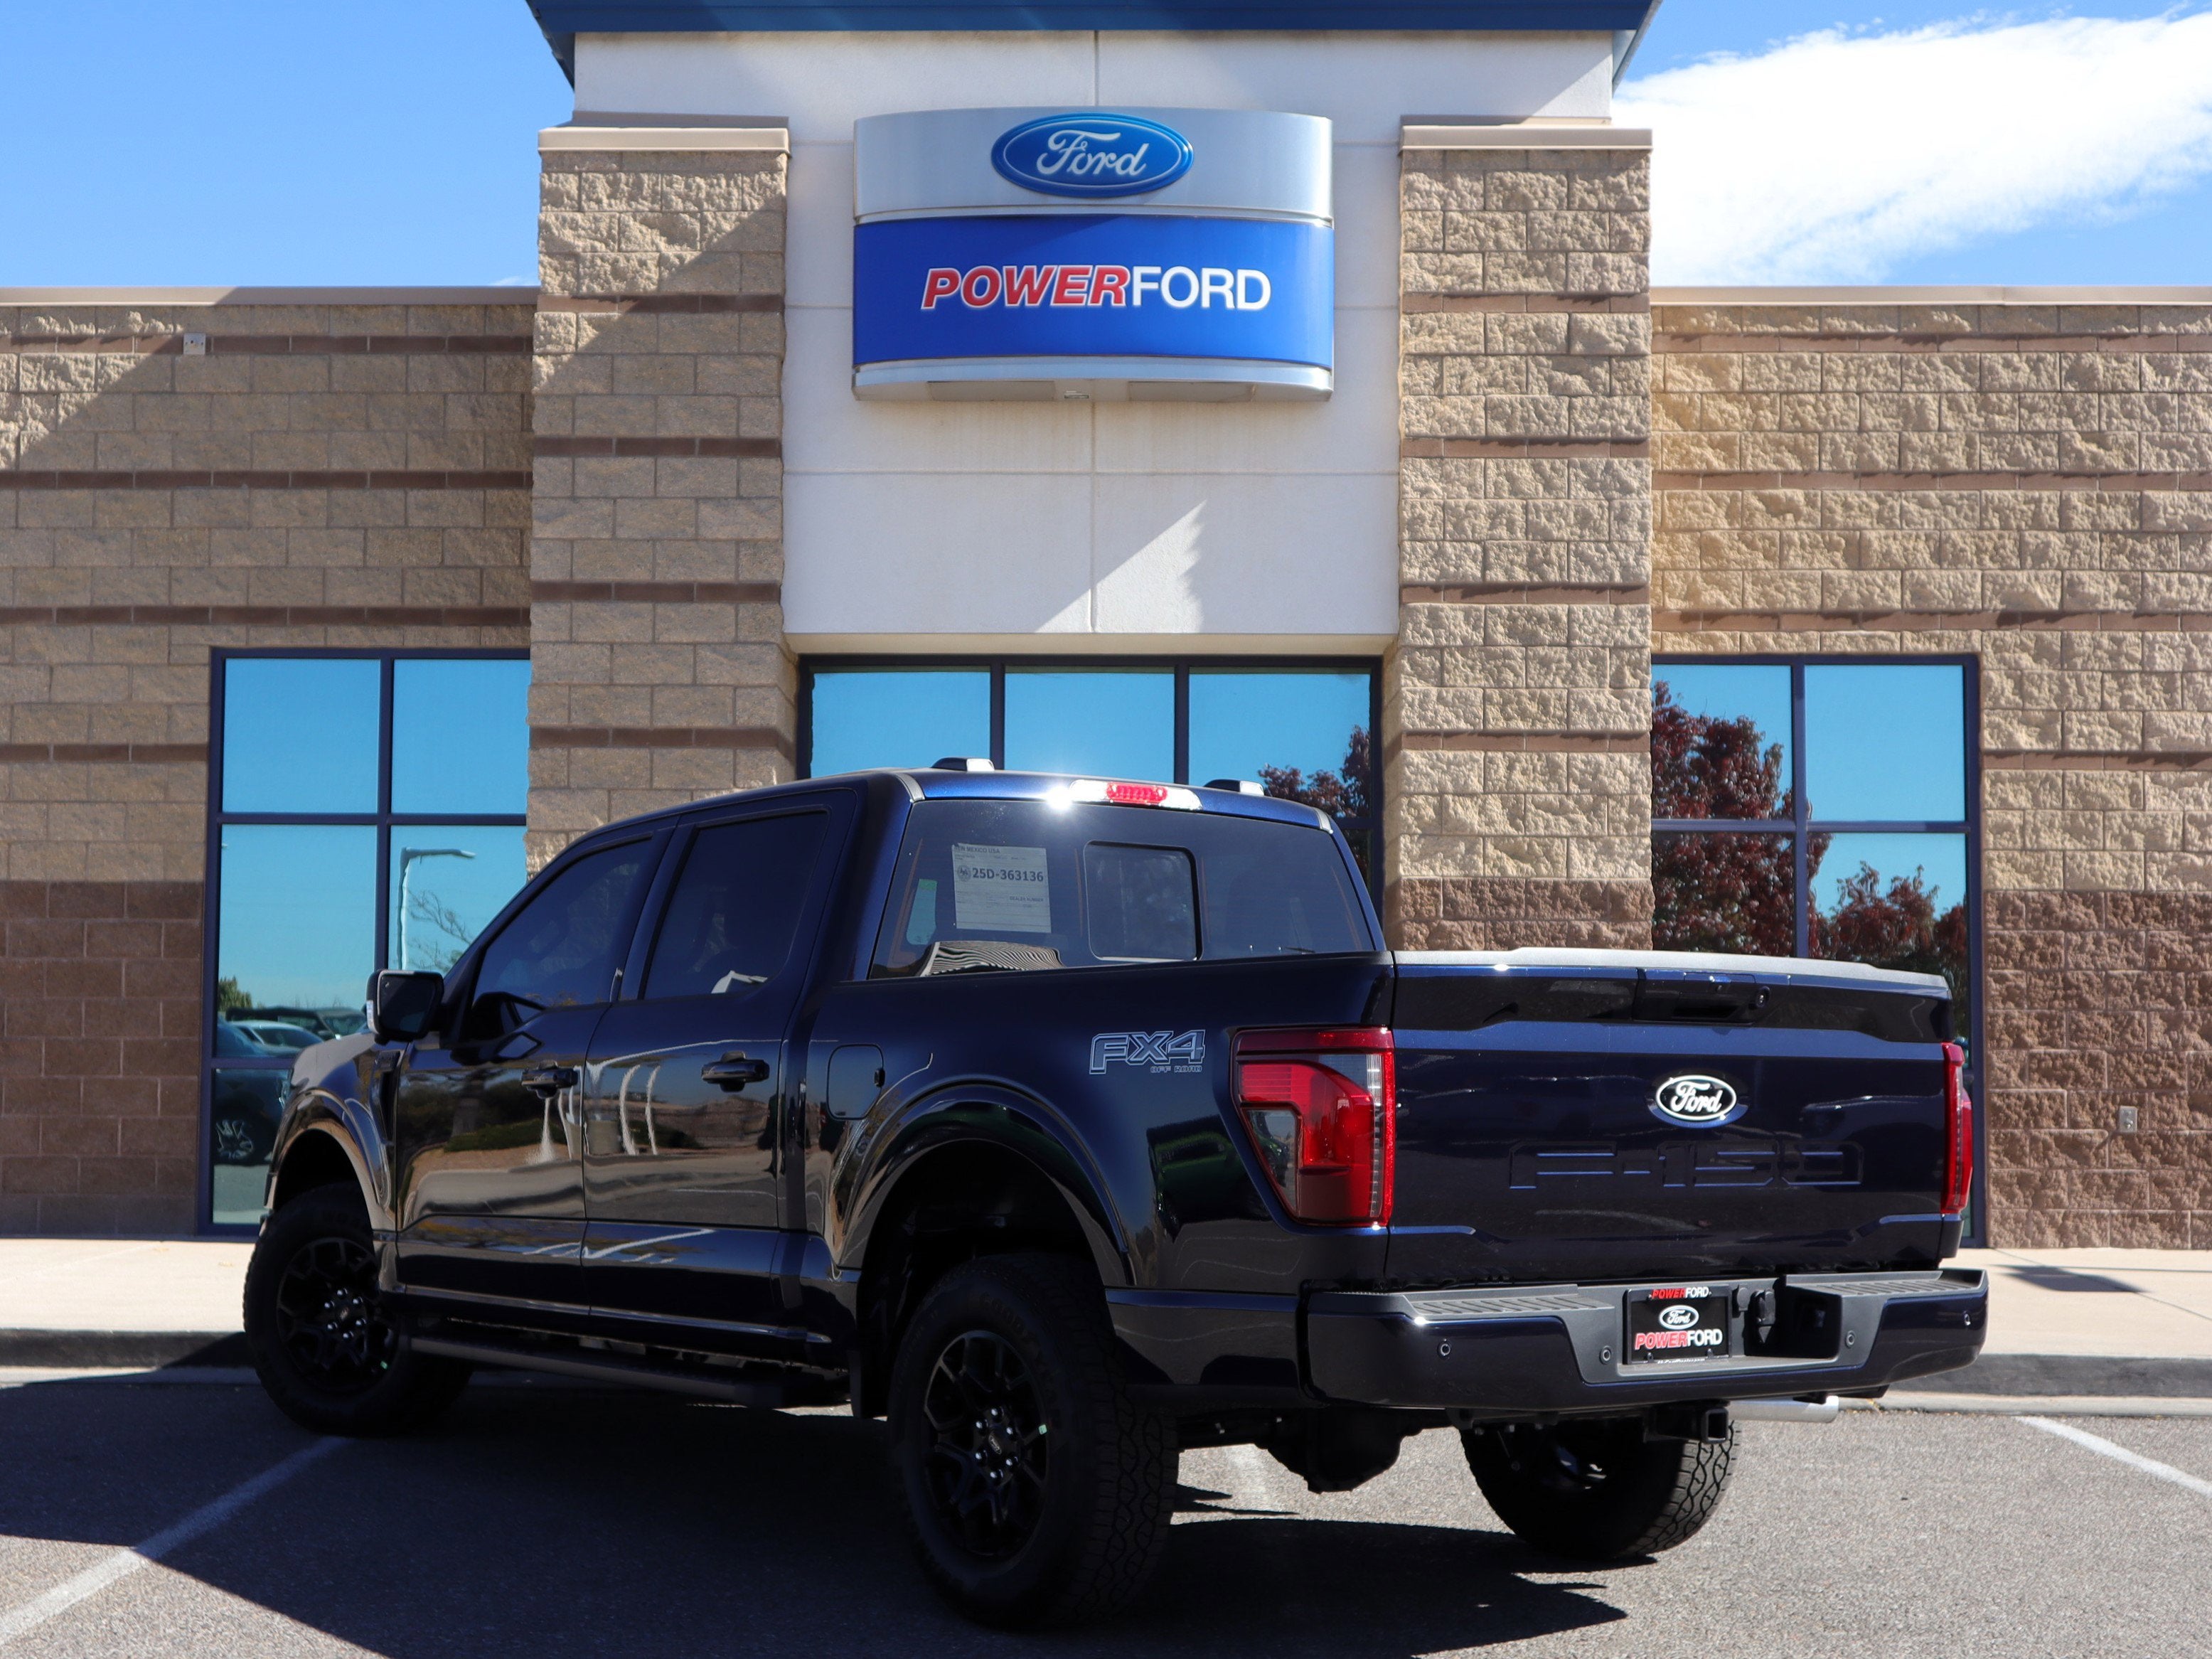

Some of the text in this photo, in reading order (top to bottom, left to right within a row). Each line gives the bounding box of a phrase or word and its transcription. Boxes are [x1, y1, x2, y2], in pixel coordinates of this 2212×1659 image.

[1035, 129, 1150, 177] Ford
[921, 265, 1271, 311] POWERFORD
[972, 867, 1044, 882] 25D-363136
[1089, 1030, 1206, 1074] FX4
[1150, 1065, 1172, 1074] OFF
[1670, 1081, 1723, 1113] Ford
[1651, 1286, 1709, 1299] POWERFORD
[1666, 1309, 1692, 1325] Ford
[1635, 1328, 1724, 1350] POWERFORD
